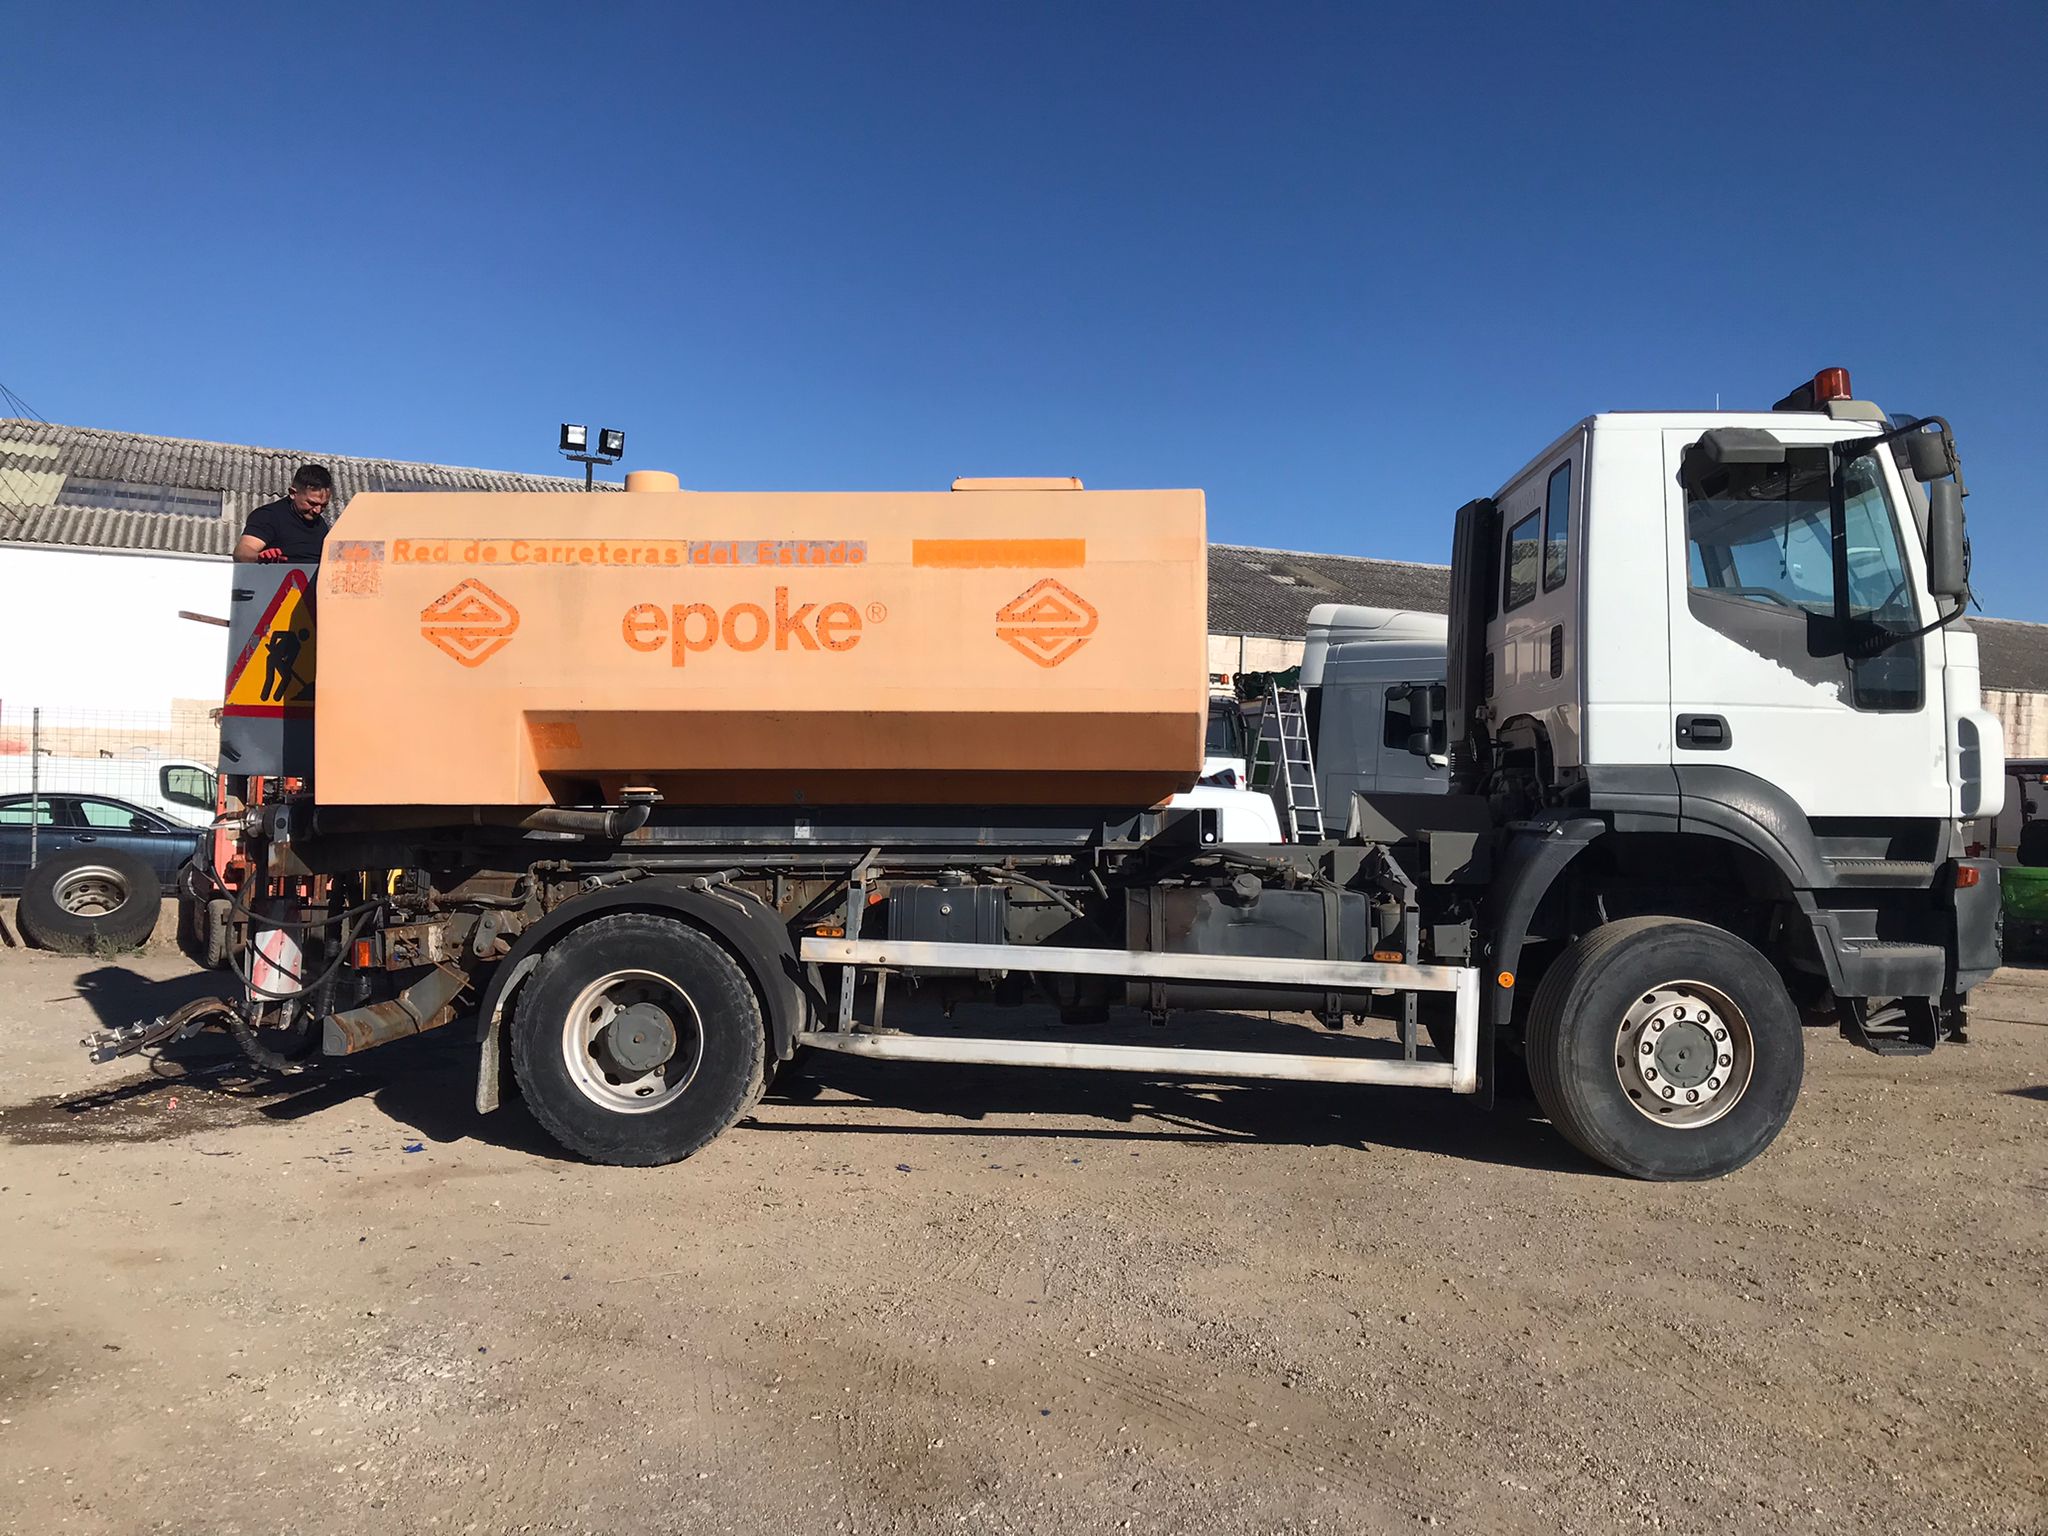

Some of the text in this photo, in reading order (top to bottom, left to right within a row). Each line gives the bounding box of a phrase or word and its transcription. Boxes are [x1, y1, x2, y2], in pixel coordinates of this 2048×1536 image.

[393, 540, 865, 565] Red de Carreteras del Estado
